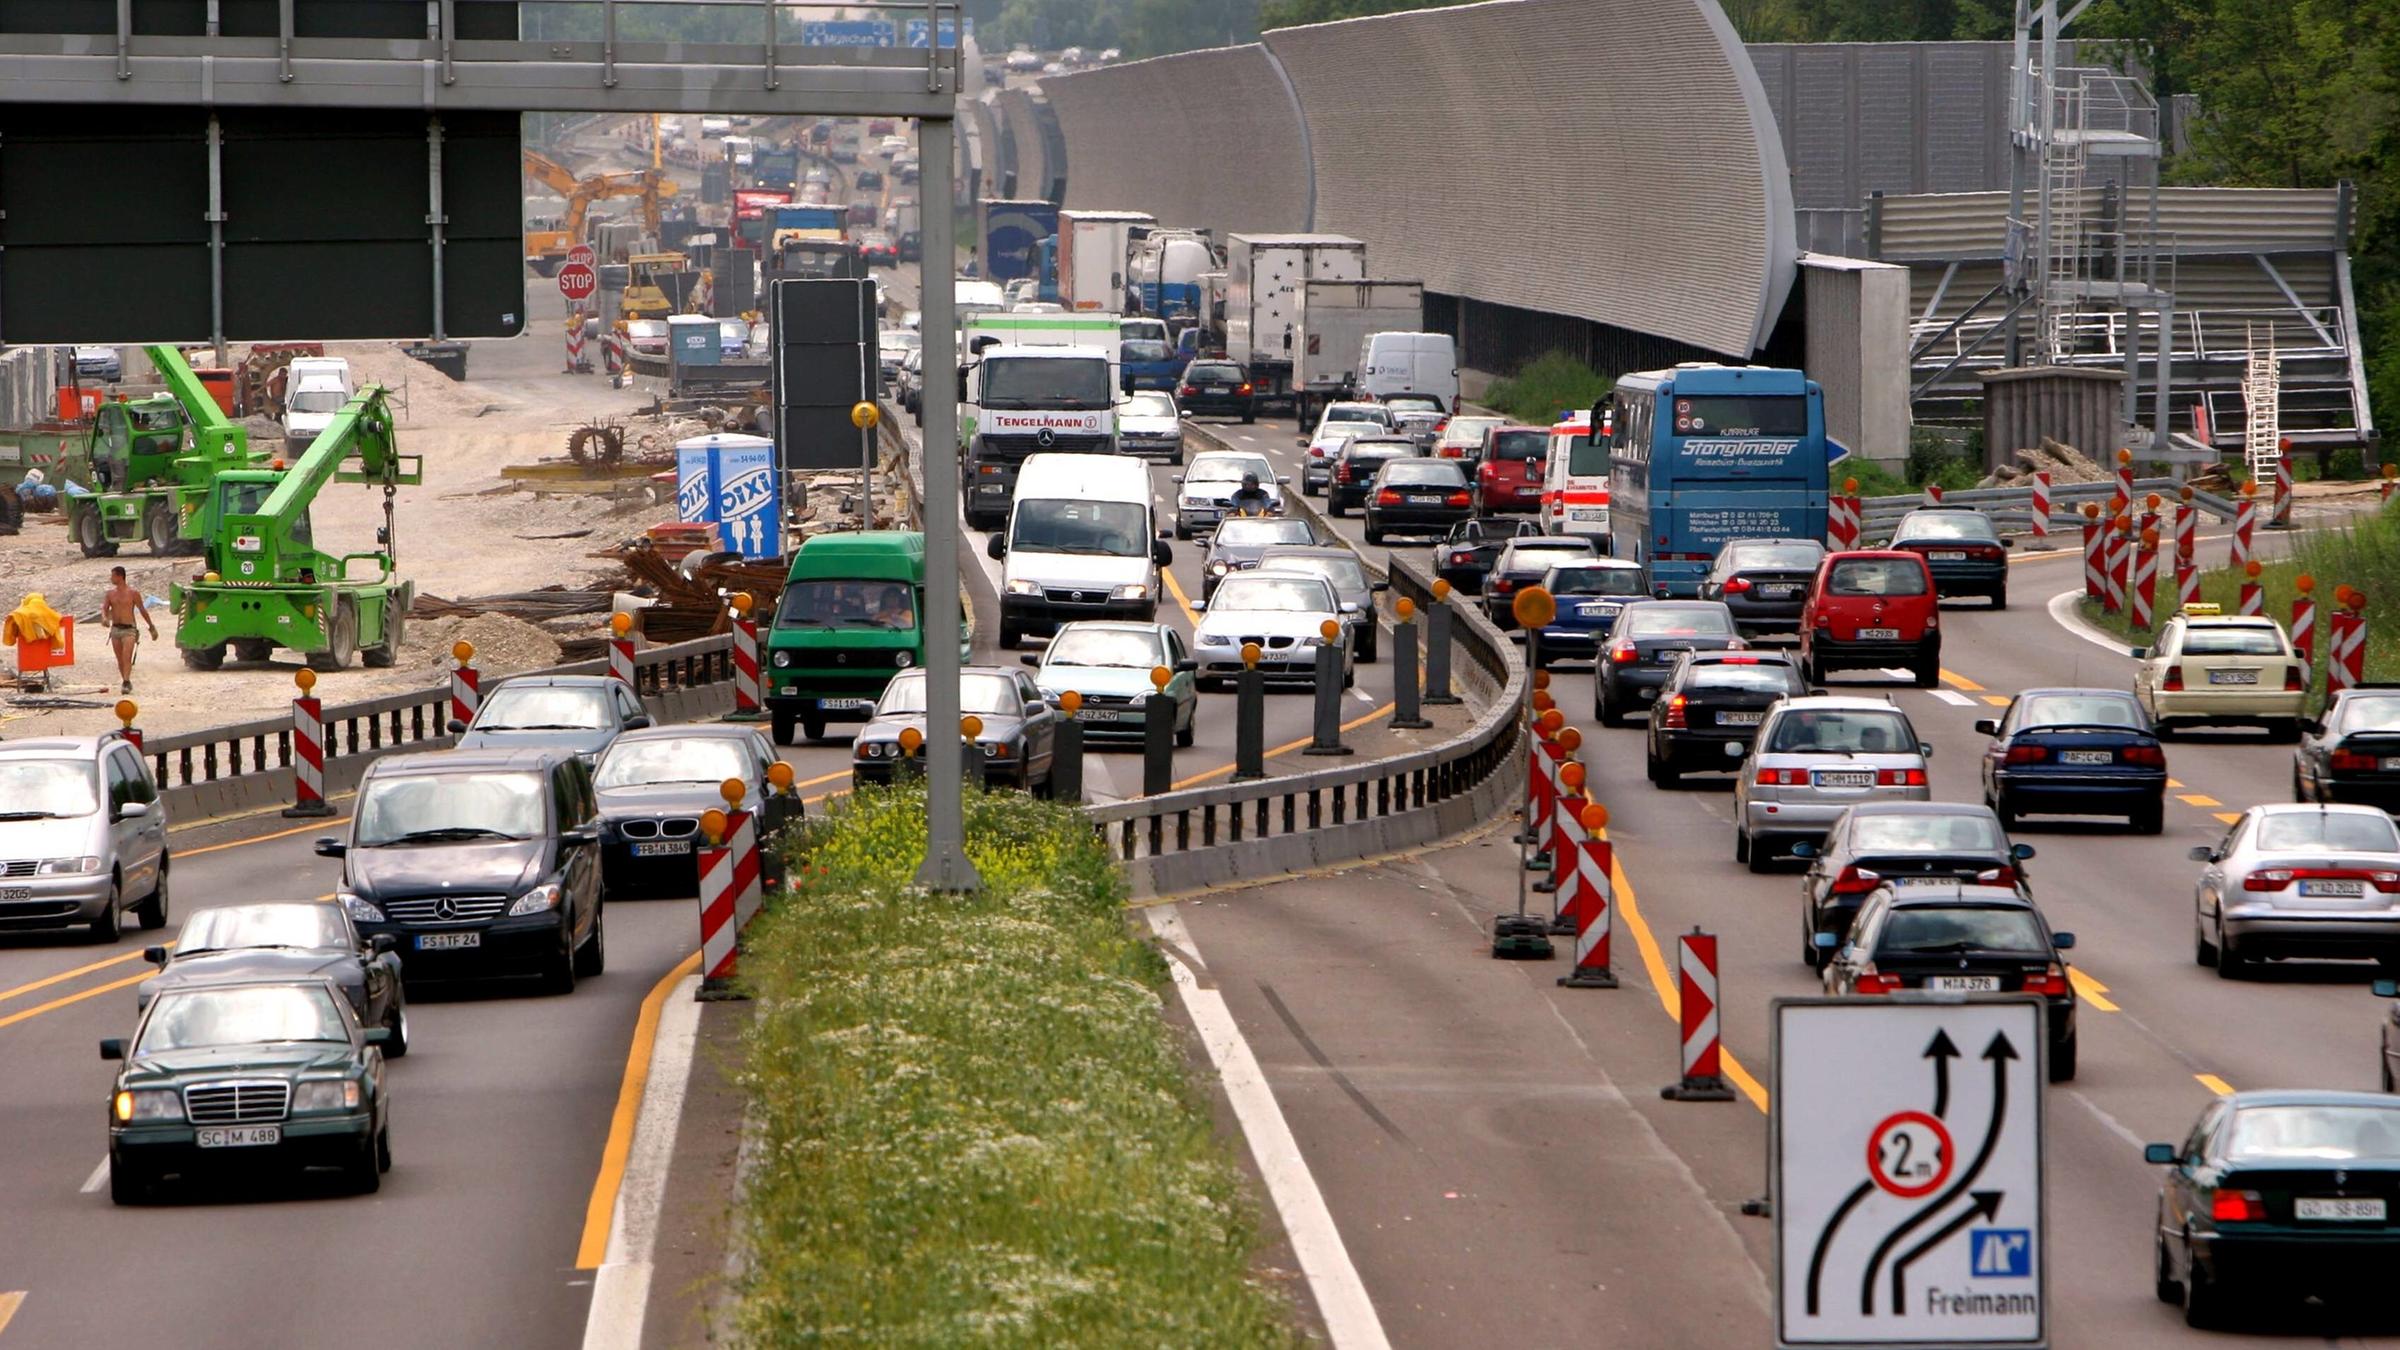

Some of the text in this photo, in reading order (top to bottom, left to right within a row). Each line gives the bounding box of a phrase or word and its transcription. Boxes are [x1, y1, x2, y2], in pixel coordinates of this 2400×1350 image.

[561, 273, 593, 290] STOP
[996, 416, 1082, 427] TENGELMANN
[1681, 439, 1800, 457] Stanglmeier
[243, 562, 253, 573] 20
[2, 889, 28, 899] 3205
[421, 934, 477, 948] FS TF 24
[201, 1129, 276, 1146] SC M 488
[1892, 1132, 1914, 1178] 2
[1927, 1286, 2036, 1317] Freimann
